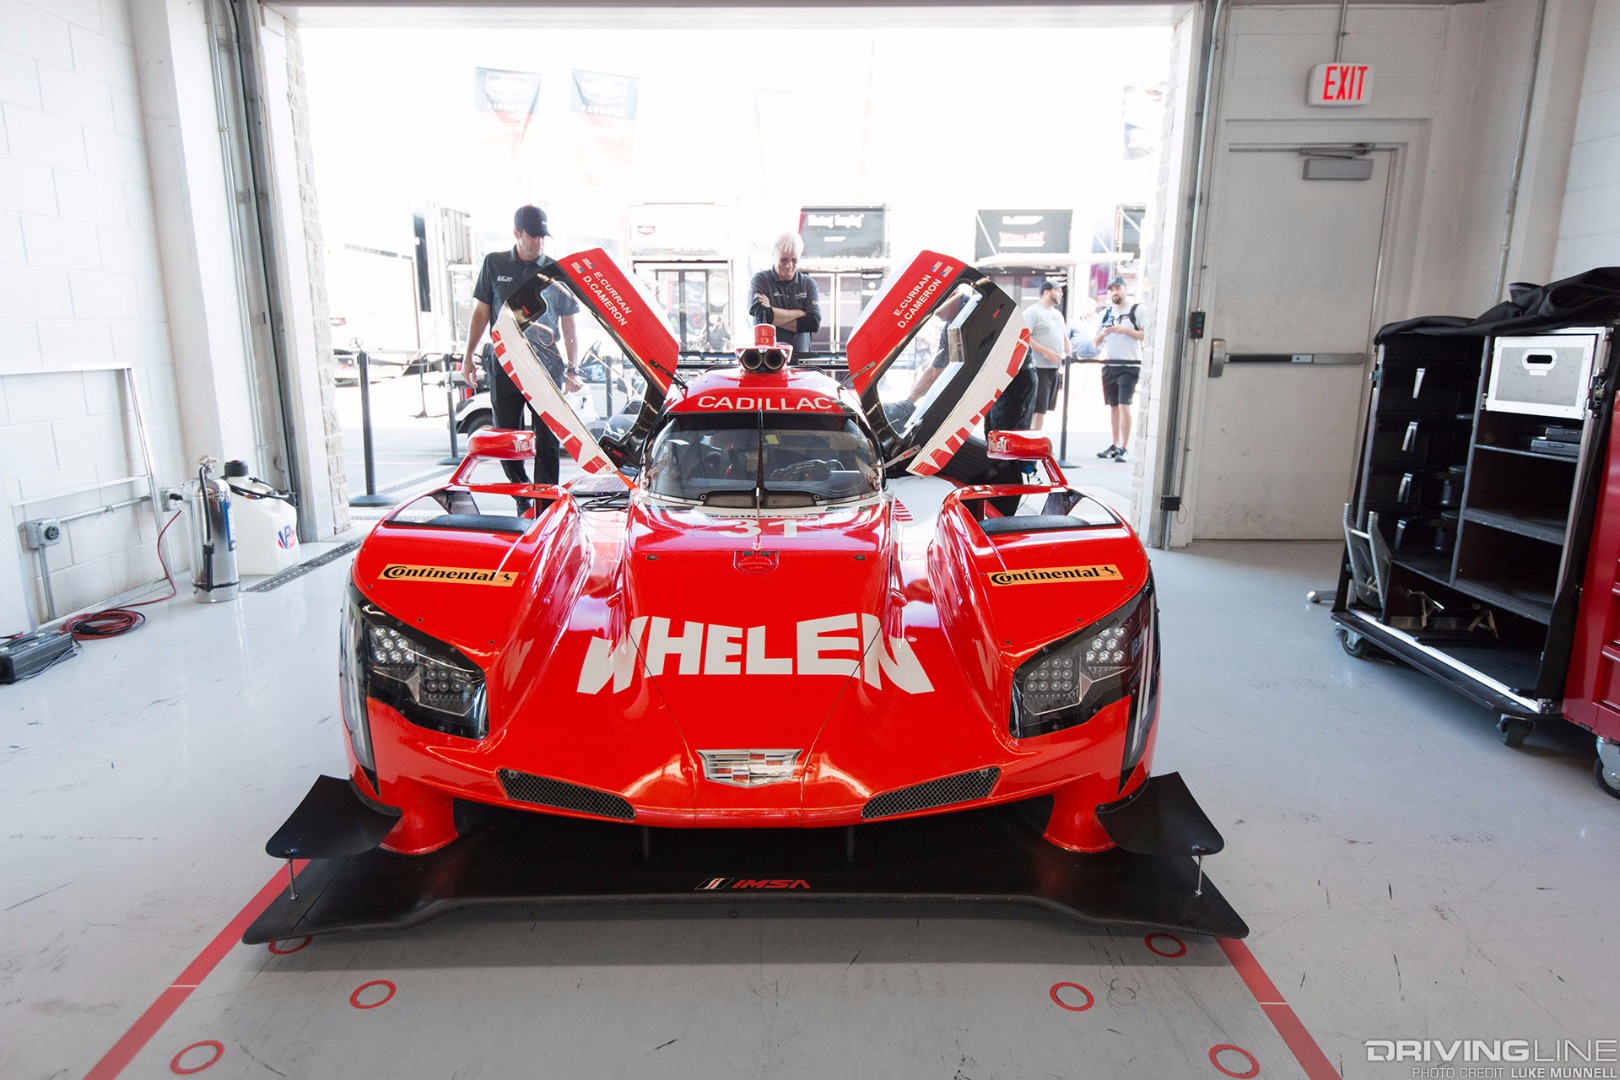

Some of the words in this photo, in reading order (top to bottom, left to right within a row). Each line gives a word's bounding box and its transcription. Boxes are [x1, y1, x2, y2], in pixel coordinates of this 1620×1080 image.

[1322, 65, 1368, 101] EXIT
[582, 275, 628, 327] D.CAMERON
[593, 271, 632, 315] E.CURRAN
[893, 274, 932, 317] E.CURRAN
[897, 278, 942, 329] D.CAMERON
[697, 395, 833, 411] CADILLAC
[718, 519, 799, 539] 31
[383, 565, 496, 582] Continental
[990, 566, 1101, 586] Continental
[576, 613, 935, 695] WHELEN
[731, 879, 811, 889] IMSA
